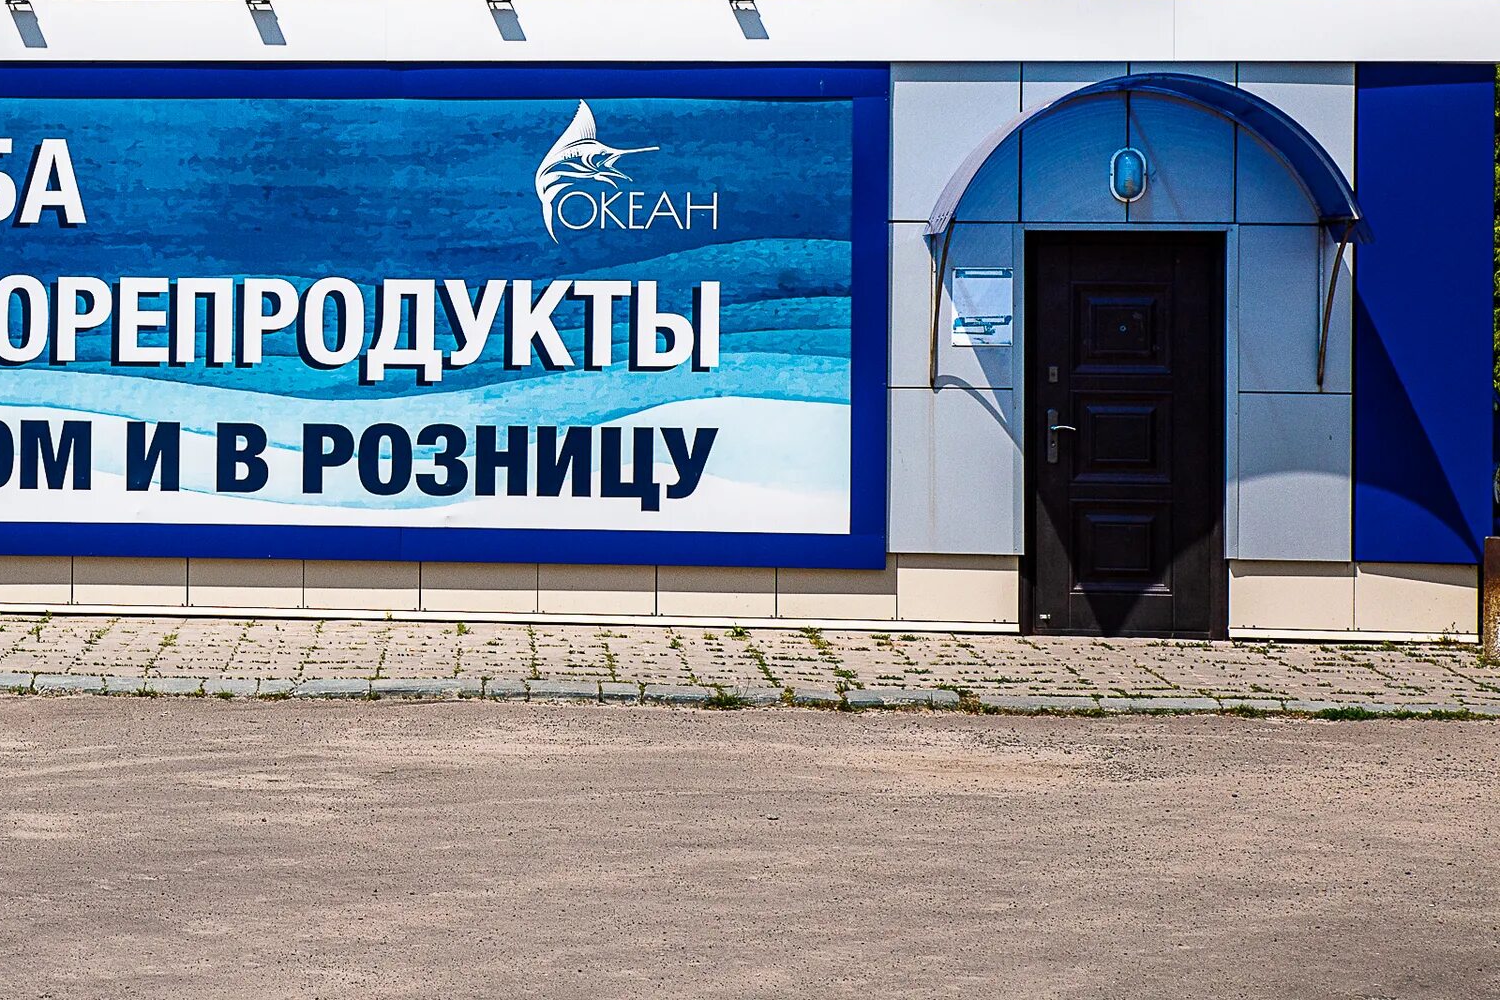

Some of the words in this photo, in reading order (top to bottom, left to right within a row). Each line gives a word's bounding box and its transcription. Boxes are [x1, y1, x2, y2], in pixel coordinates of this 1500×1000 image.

[557, 190, 718, 230] ОКЕАН
[126, 421, 181, 492] И
[216, 422, 269, 493] В
[302, 422, 719, 512] РОЗНИЦУ
